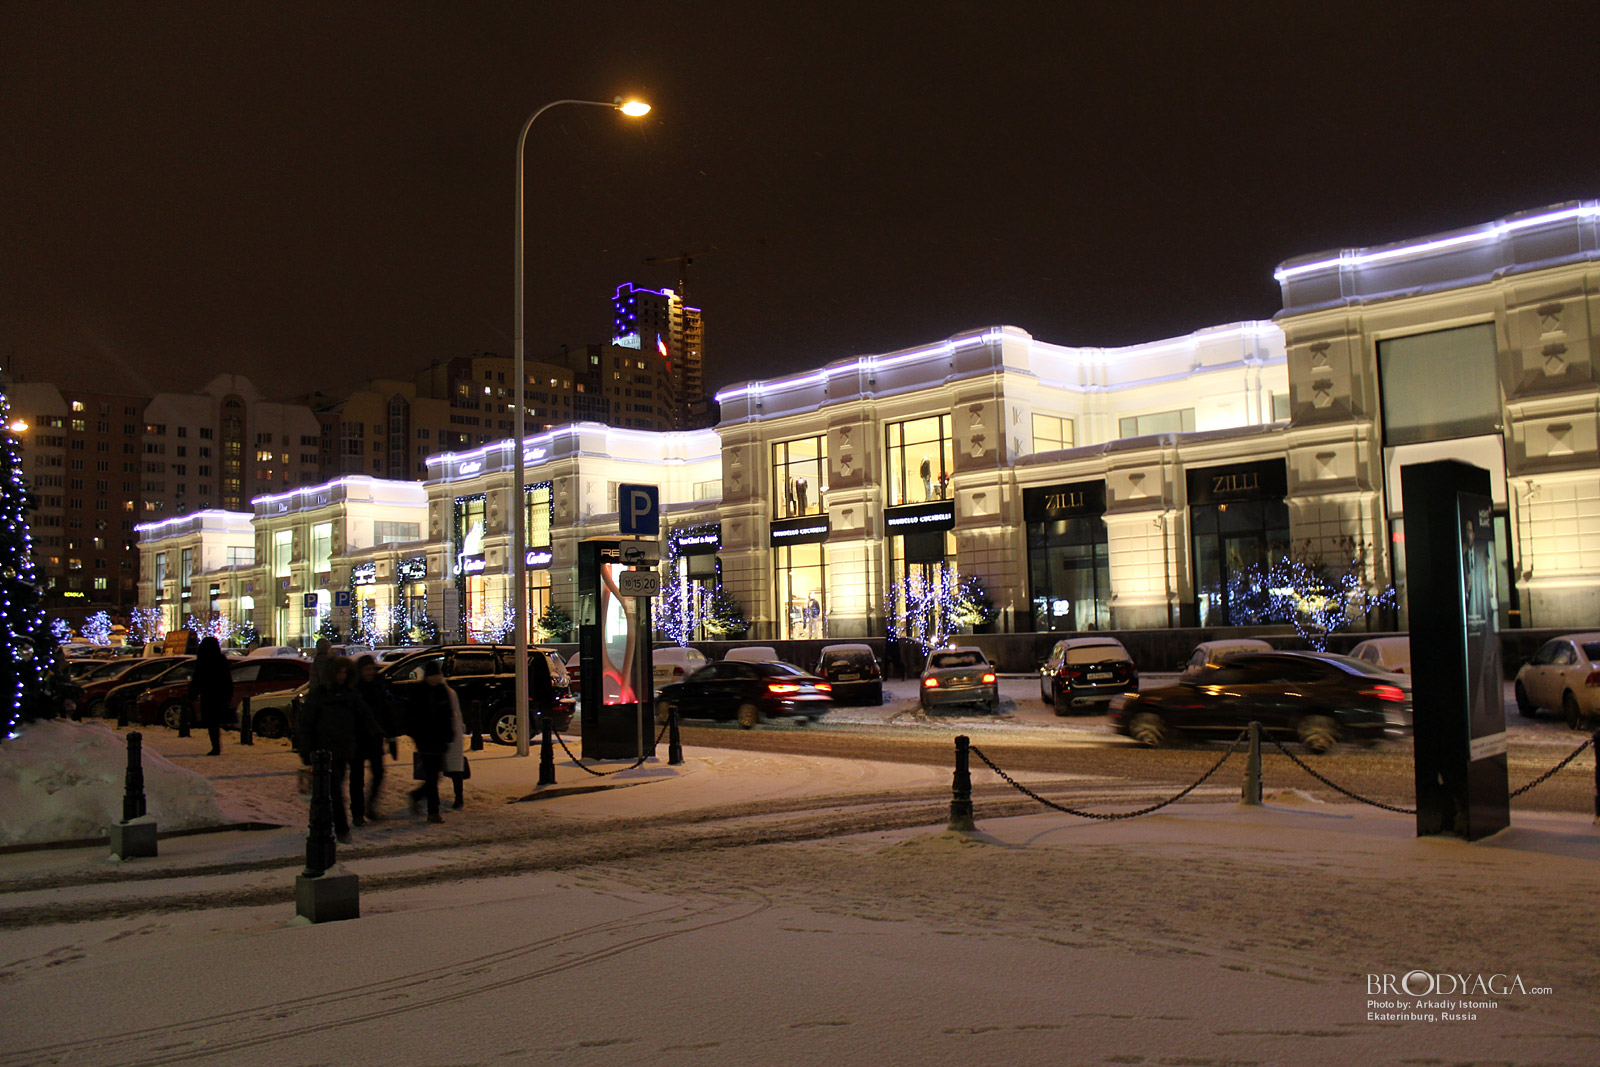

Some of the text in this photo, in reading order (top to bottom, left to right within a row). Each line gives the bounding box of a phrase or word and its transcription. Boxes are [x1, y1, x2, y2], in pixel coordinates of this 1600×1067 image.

[459, 462, 481, 475] Cartier
[1212, 472, 1260, 493] ZILLI
[1045, 491, 1084, 510] ZILLI
[630, 490, 652, 529] P
[464, 559, 486, 571] Cartier
[527, 552, 552, 565] Cartier
[633, 580, 641, 589] 15
[644, 579, 656, 589] 20
[307, 595, 316, 605] P
[340, 593, 348, 605] P
